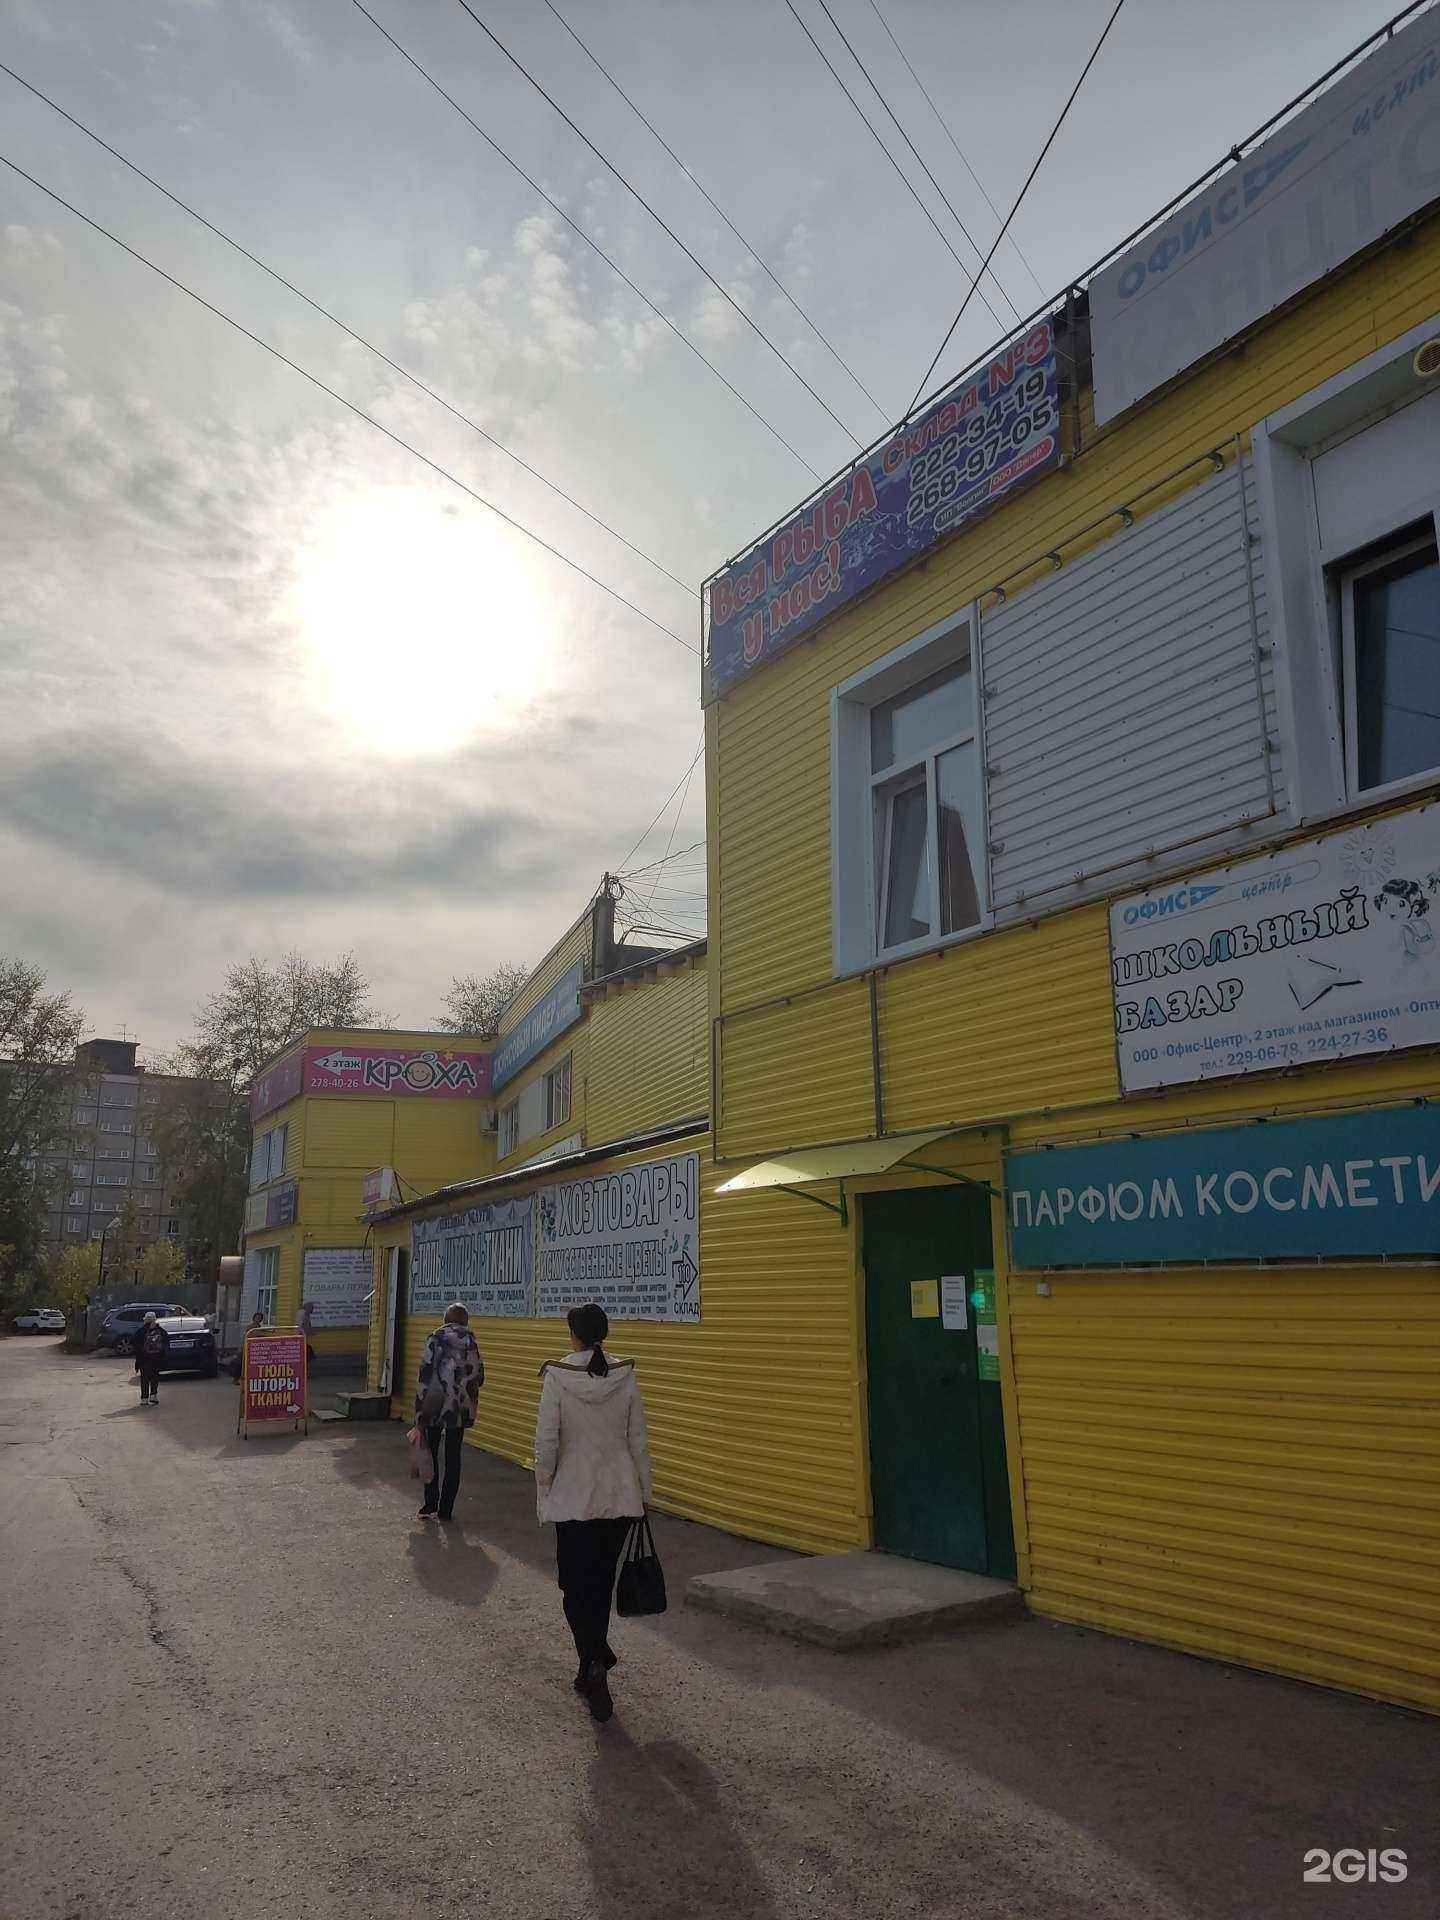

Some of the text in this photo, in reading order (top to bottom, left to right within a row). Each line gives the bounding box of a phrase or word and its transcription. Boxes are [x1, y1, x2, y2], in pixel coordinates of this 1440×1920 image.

[1118, 186, 1239, 298] ОФИС
[909, 371, 1047, 491] 222-34-19
[906, 402, 1053, 527] 268-97-05
[1123, 891, 1187, 925] ОФИС
[1113, 886, 1369, 987] ШКОЛЬНЫЙ
[1116, 978, 1244, 1034] БАЗАР
[1254, 1030, 1262, 1041] 2
[1265, 1025, 1296, 1039] этаж
[1298, 1022, 1322, 1034] над
[1324, 1006, 1401, 1029] магазином
[1307, 1027, 1388, 1051] 224-27-36
[323, 1058, 361, 1069] 2 этаж
[364, 1052, 477, 1091] КРОХА
[558, 1158, 696, 1238] ХОЗТОВАРЫ
[1012, 1177, 1185, 1228] ПАРФЮМ
[443, 1232, 481, 1288] ШТОРЫ
[484, 1225, 523, 1286] ТКАНИ
[539, 1238, 668, 1283] ИСКУССТВЕННЫЕ ЦВЕТЫ
[673, 1302, 700, 1318] СКЛАД
[249, 1377, 299, 1392] ШТОРЫ
[257, 1364, 294, 1378] ТЮЛЬ
[249, 1392, 292, 1407] ТКАНИ
